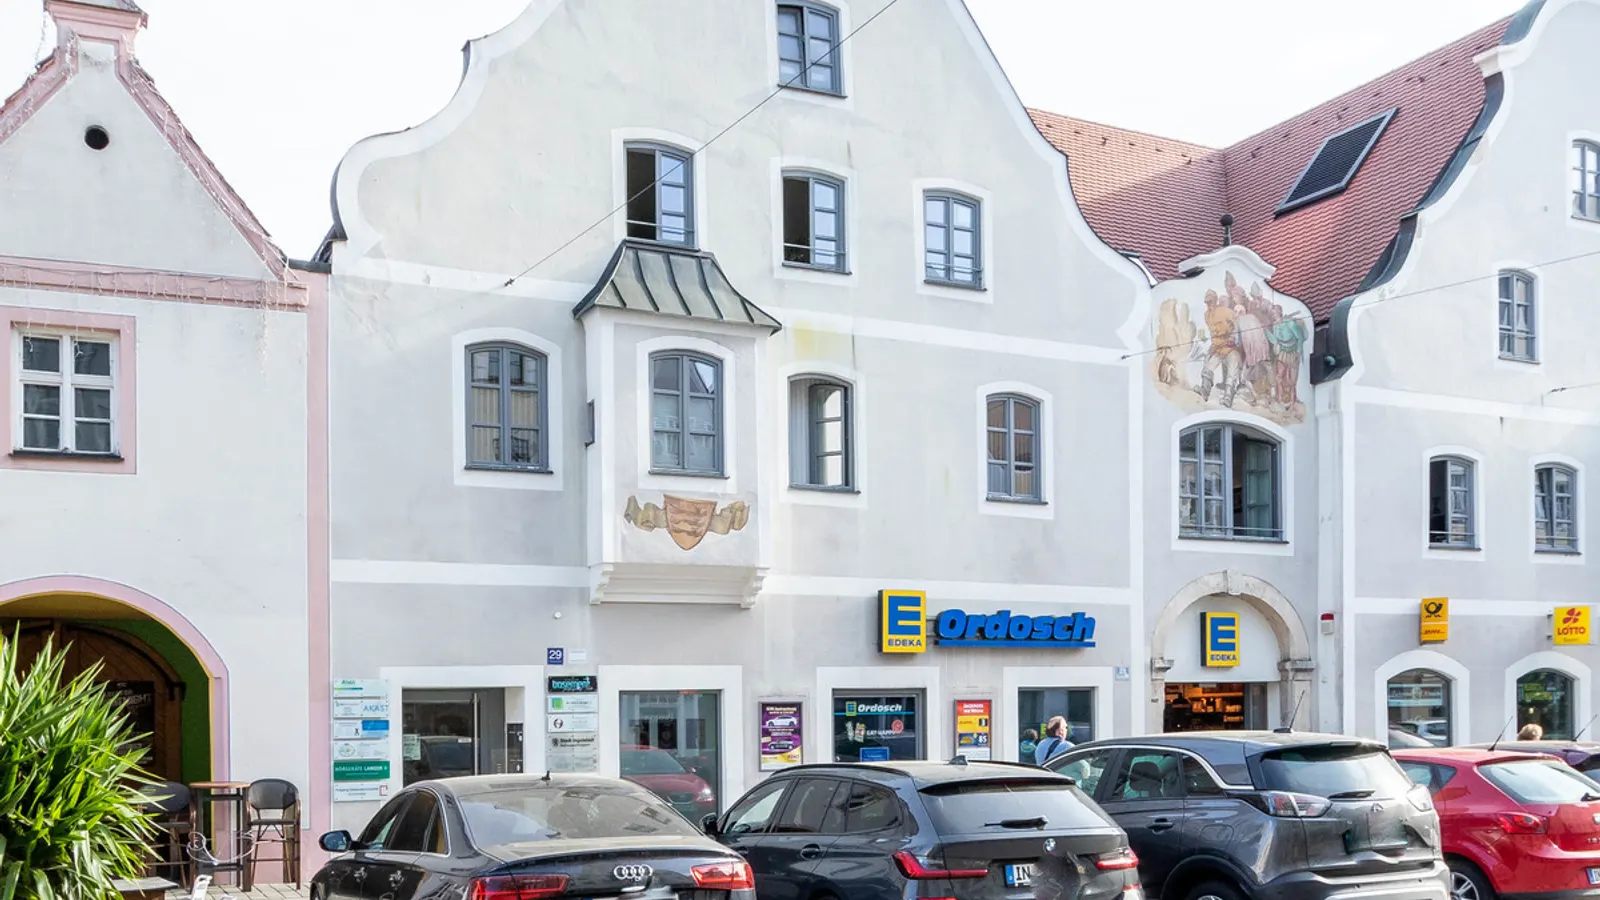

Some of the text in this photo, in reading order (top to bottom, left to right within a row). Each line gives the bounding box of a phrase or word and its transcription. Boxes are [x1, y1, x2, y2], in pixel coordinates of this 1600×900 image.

[888, 595, 921, 635] E
[936, 609, 1096, 641] Ordosch
[1557, 626, 1587, 635] LOTTO
[1210, 617, 1236, 651] E
[888, 638, 922, 647] EDEKA
[549, 649, 563, 660] 29
[857, 703, 902, 713] Ordosch
[1015, 866, 1031, 880] IN
